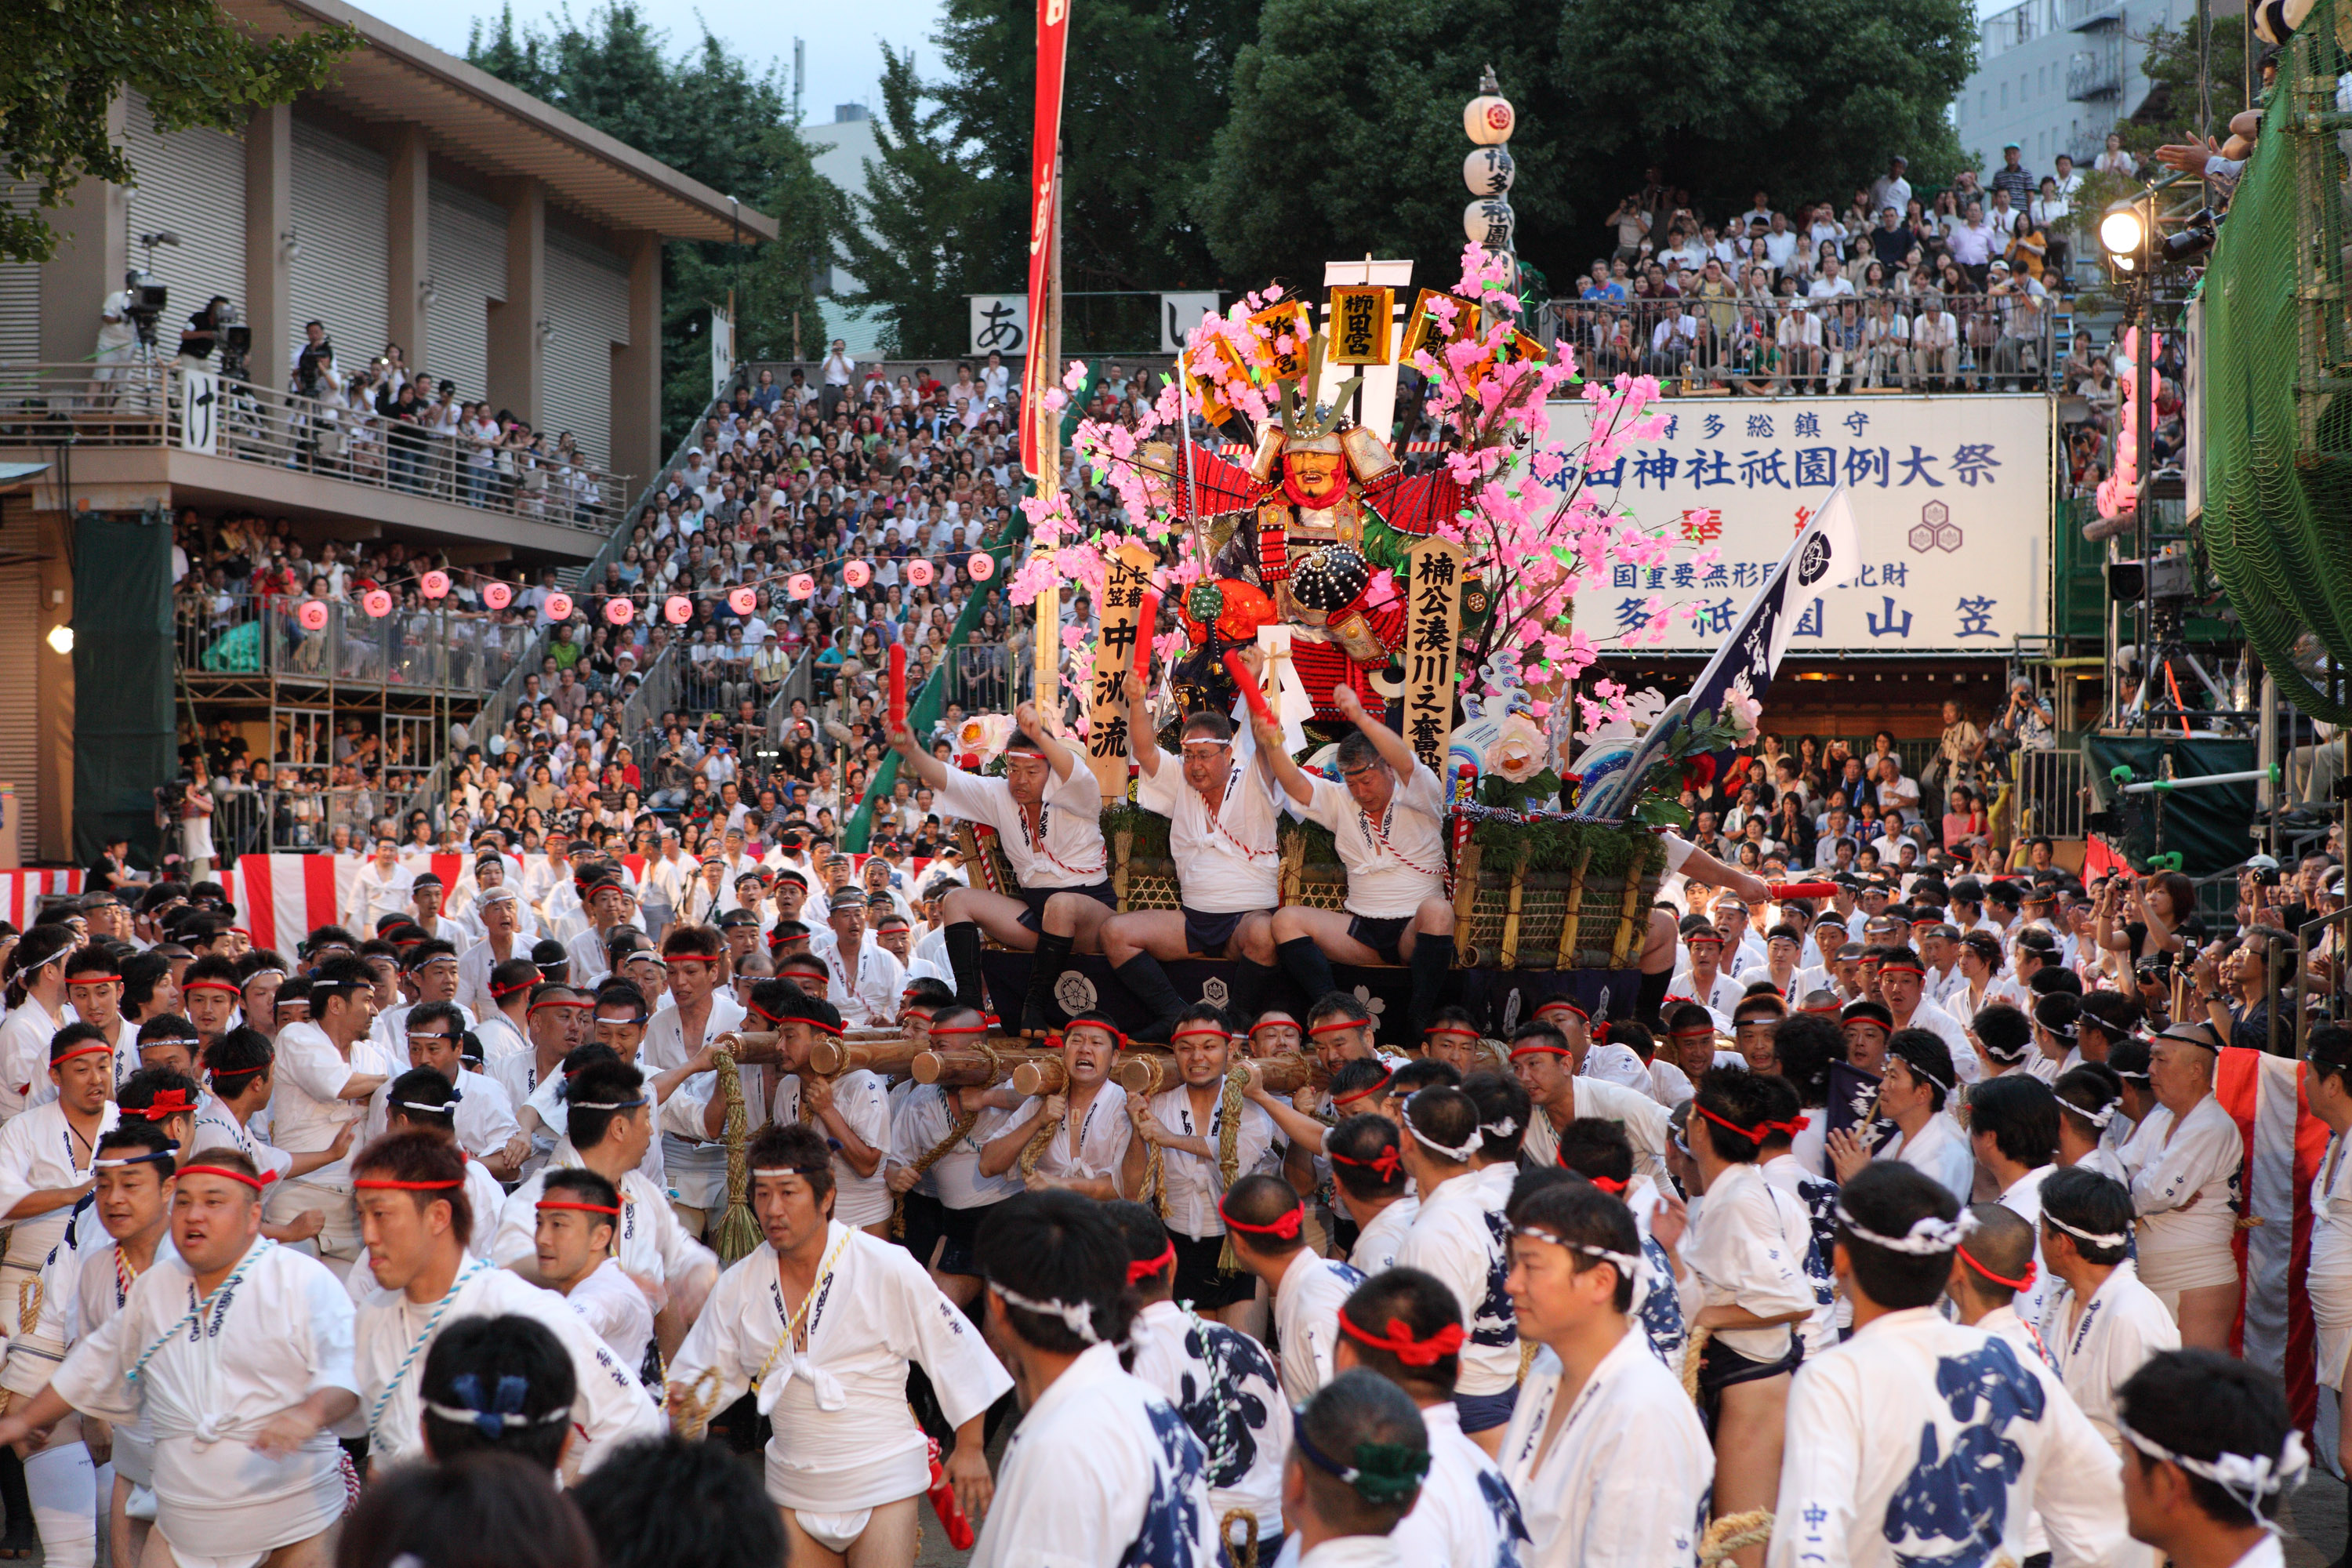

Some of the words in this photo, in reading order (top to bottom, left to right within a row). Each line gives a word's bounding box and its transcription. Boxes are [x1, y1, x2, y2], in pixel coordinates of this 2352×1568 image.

[977, 300, 1023, 350] あ
[1343, 294, 1374, 356] 櫛田宮
[189, 377, 214, 448] け
[1105, 565, 1128, 608] 山笠
[1124, 565, 1148, 609] 七番
[1091, 617, 1138, 759] 中洲流
